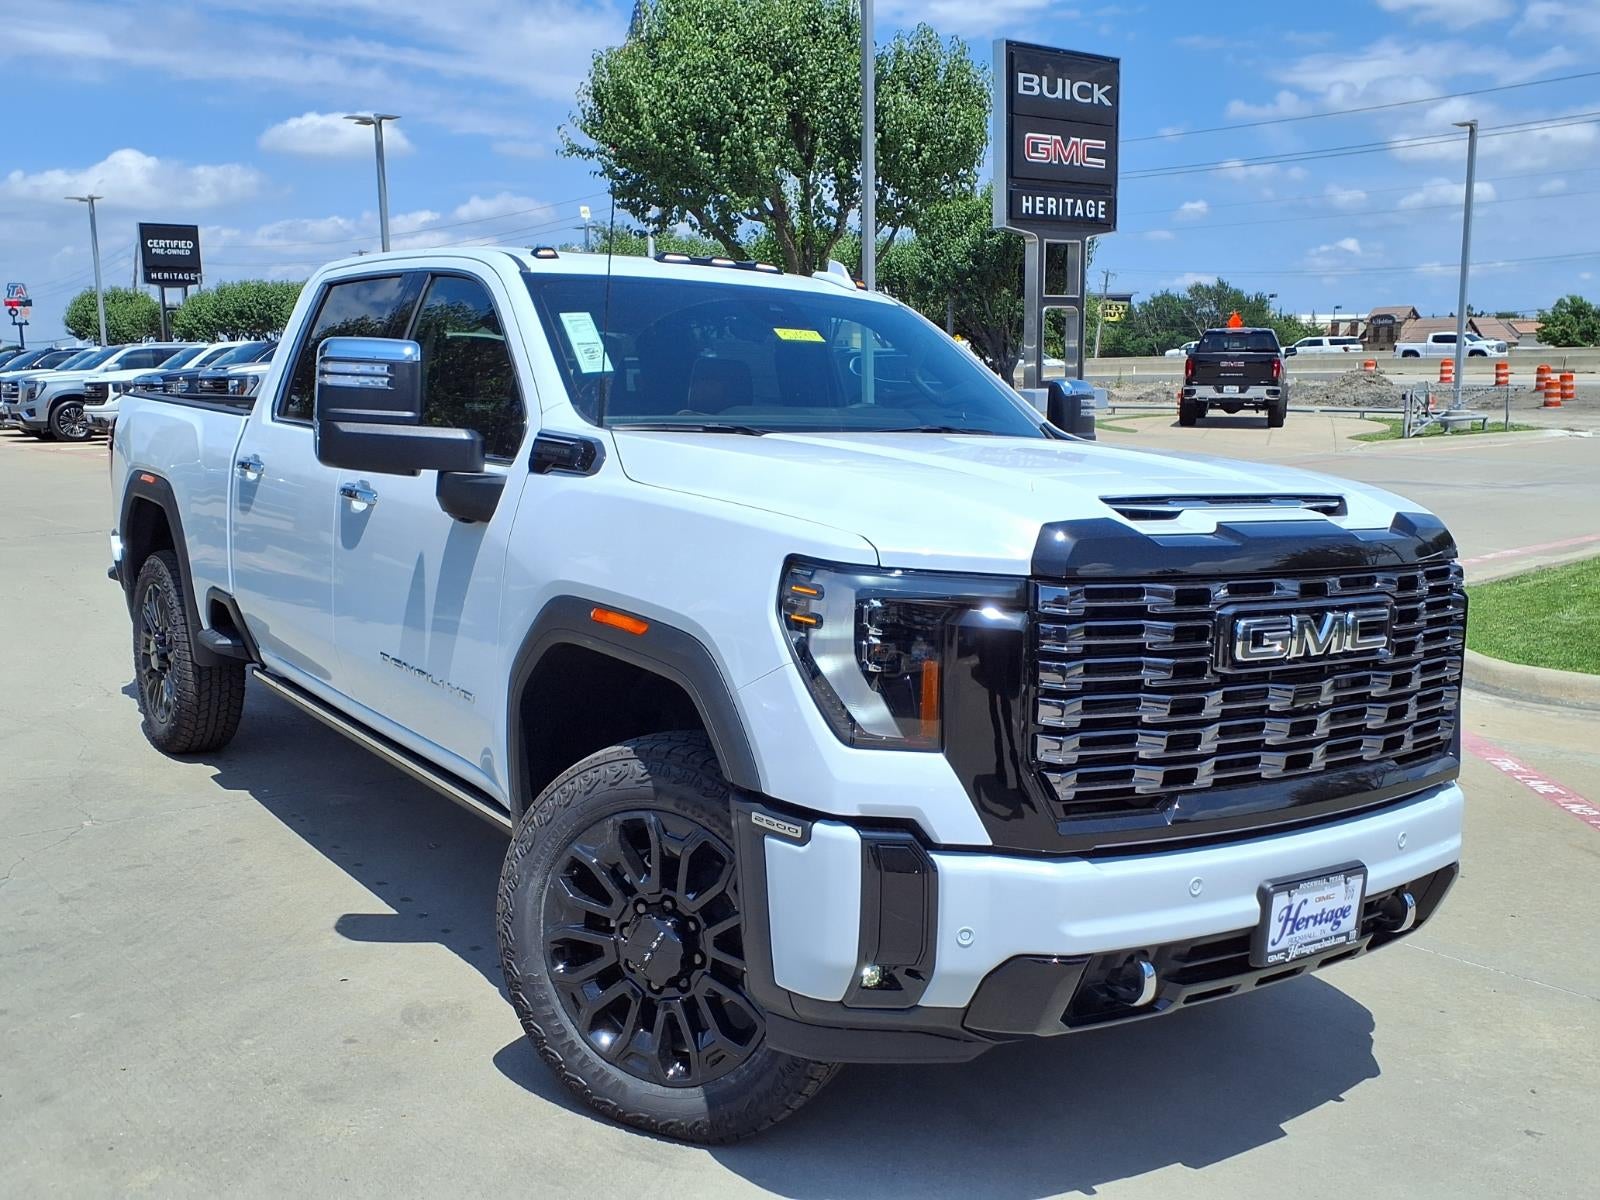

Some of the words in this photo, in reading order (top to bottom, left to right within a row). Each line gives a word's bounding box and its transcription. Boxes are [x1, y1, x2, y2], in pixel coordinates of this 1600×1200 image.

[1017, 72, 1112, 107] BUICK
[1024, 132, 1106, 169] GMC
[1022, 195, 1106, 218] HERITAGE
[147, 239, 194, 249] CERTIFIED
[151, 248, 191, 256] PRE-OWNED
[150, 272, 196, 280] HERITAGE
[9, 284, 26, 297] TA
[1235, 608, 1390, 662] GMC
[753, 815, 799, 834] 2500
[1315, 893, 1335, 903] GMC
[1270, 898, 1352, 947] Heritage
[1268, 952, 1286, 963] GMC
